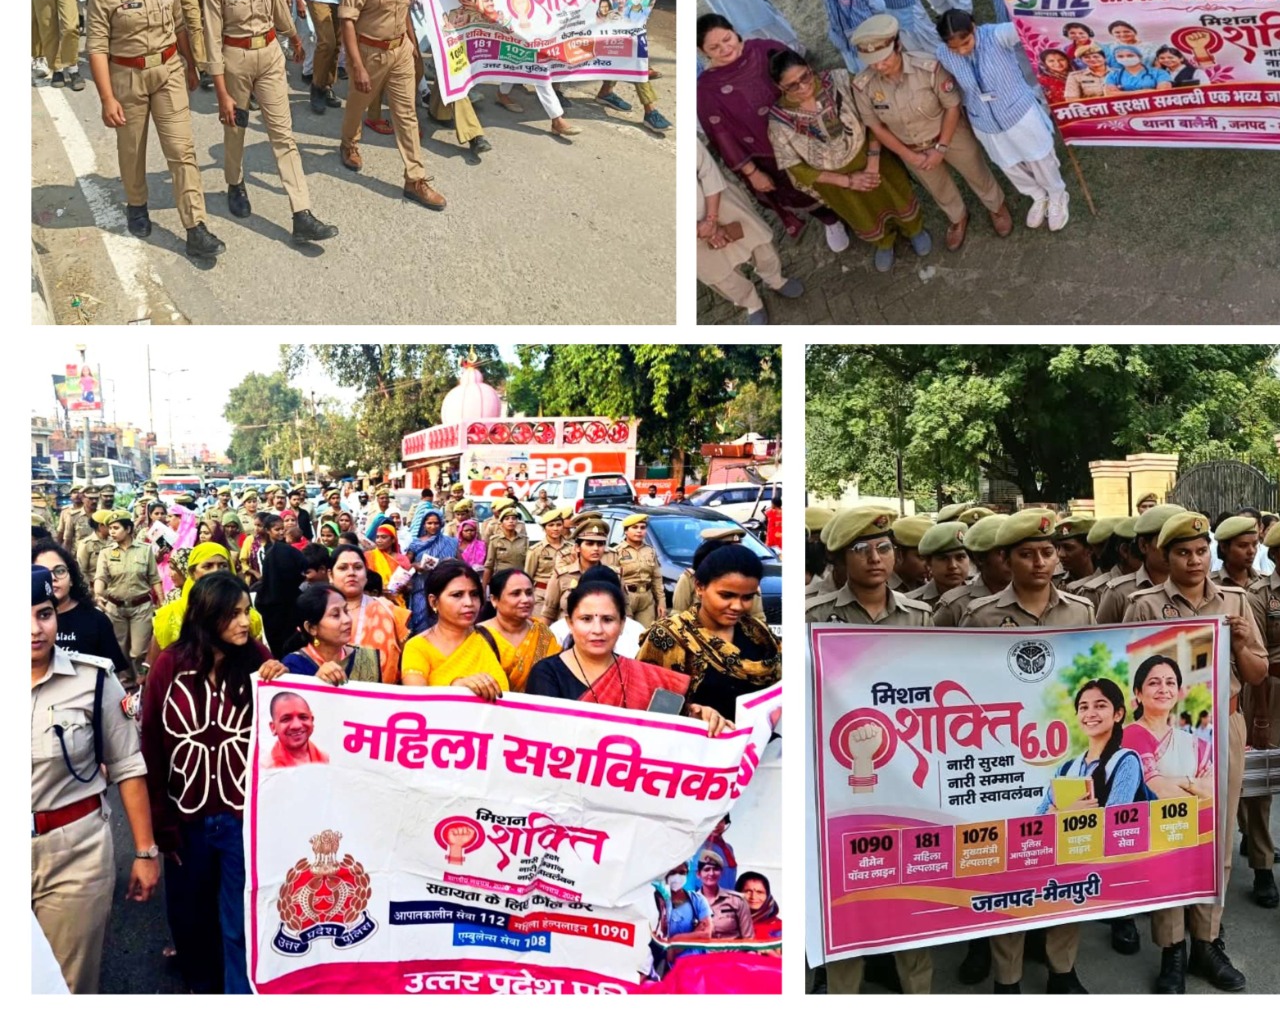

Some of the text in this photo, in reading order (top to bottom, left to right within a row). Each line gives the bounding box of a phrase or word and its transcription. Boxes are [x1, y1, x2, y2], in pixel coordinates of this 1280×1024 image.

[1200, 14, 1257, 27] मिशन
[1054, 102, 1108, 120] महिला
[1113, 98, 1150, 116] सुरक्षा
[1208, 89, 1230, 103] एक
[1234, 90, 1261, 103] भव्य
[1142, 119, 1174, 128] थाना
[1229, 120, 1266, 131] जनपद
[530, 456, 593, 475] ERO
[56, 632, 76, 640] black
[871, 681, 932, 708] मिशन
[343, 712, 493, 771] महिला
[896, 680, 1068, 790] शक्ति 6.0
[946, 754, 1015, 774] नारी सुरक्षा
[947, 772, 1025, 790] नारी सम्मान
[949, 784, 1044, 808] नारी स्वावलंबन
[476, 808, 527, 828] मिशन
[1113, 808, 1140, 826] 102
[1161, 802, 1188, 820] 108
[1018, 820, 1044, 837] 112
[1062, 813, 1098, 833] 1098
[486, 811, 610, 872] शक्ति
[849, 834, 894, 856] 1090
[915, 833, 941, 849] 181
[962, 826, 998, 845] 1076
[913, 850, 942, 864] महिला
[906, 862, 949, 876] हेल्पलाइन
[426, 882, 502, 906] सहायता के
[393, 908, 504, 927] आपातकालीन सेवा 112
[278, 922, 372, 952] उत्तर प्रदेश पुलिस
[500, 934, 520, 947] सेवा
[524, 936, 547, 948] 108
[592, 923, 629, 941] 1090
